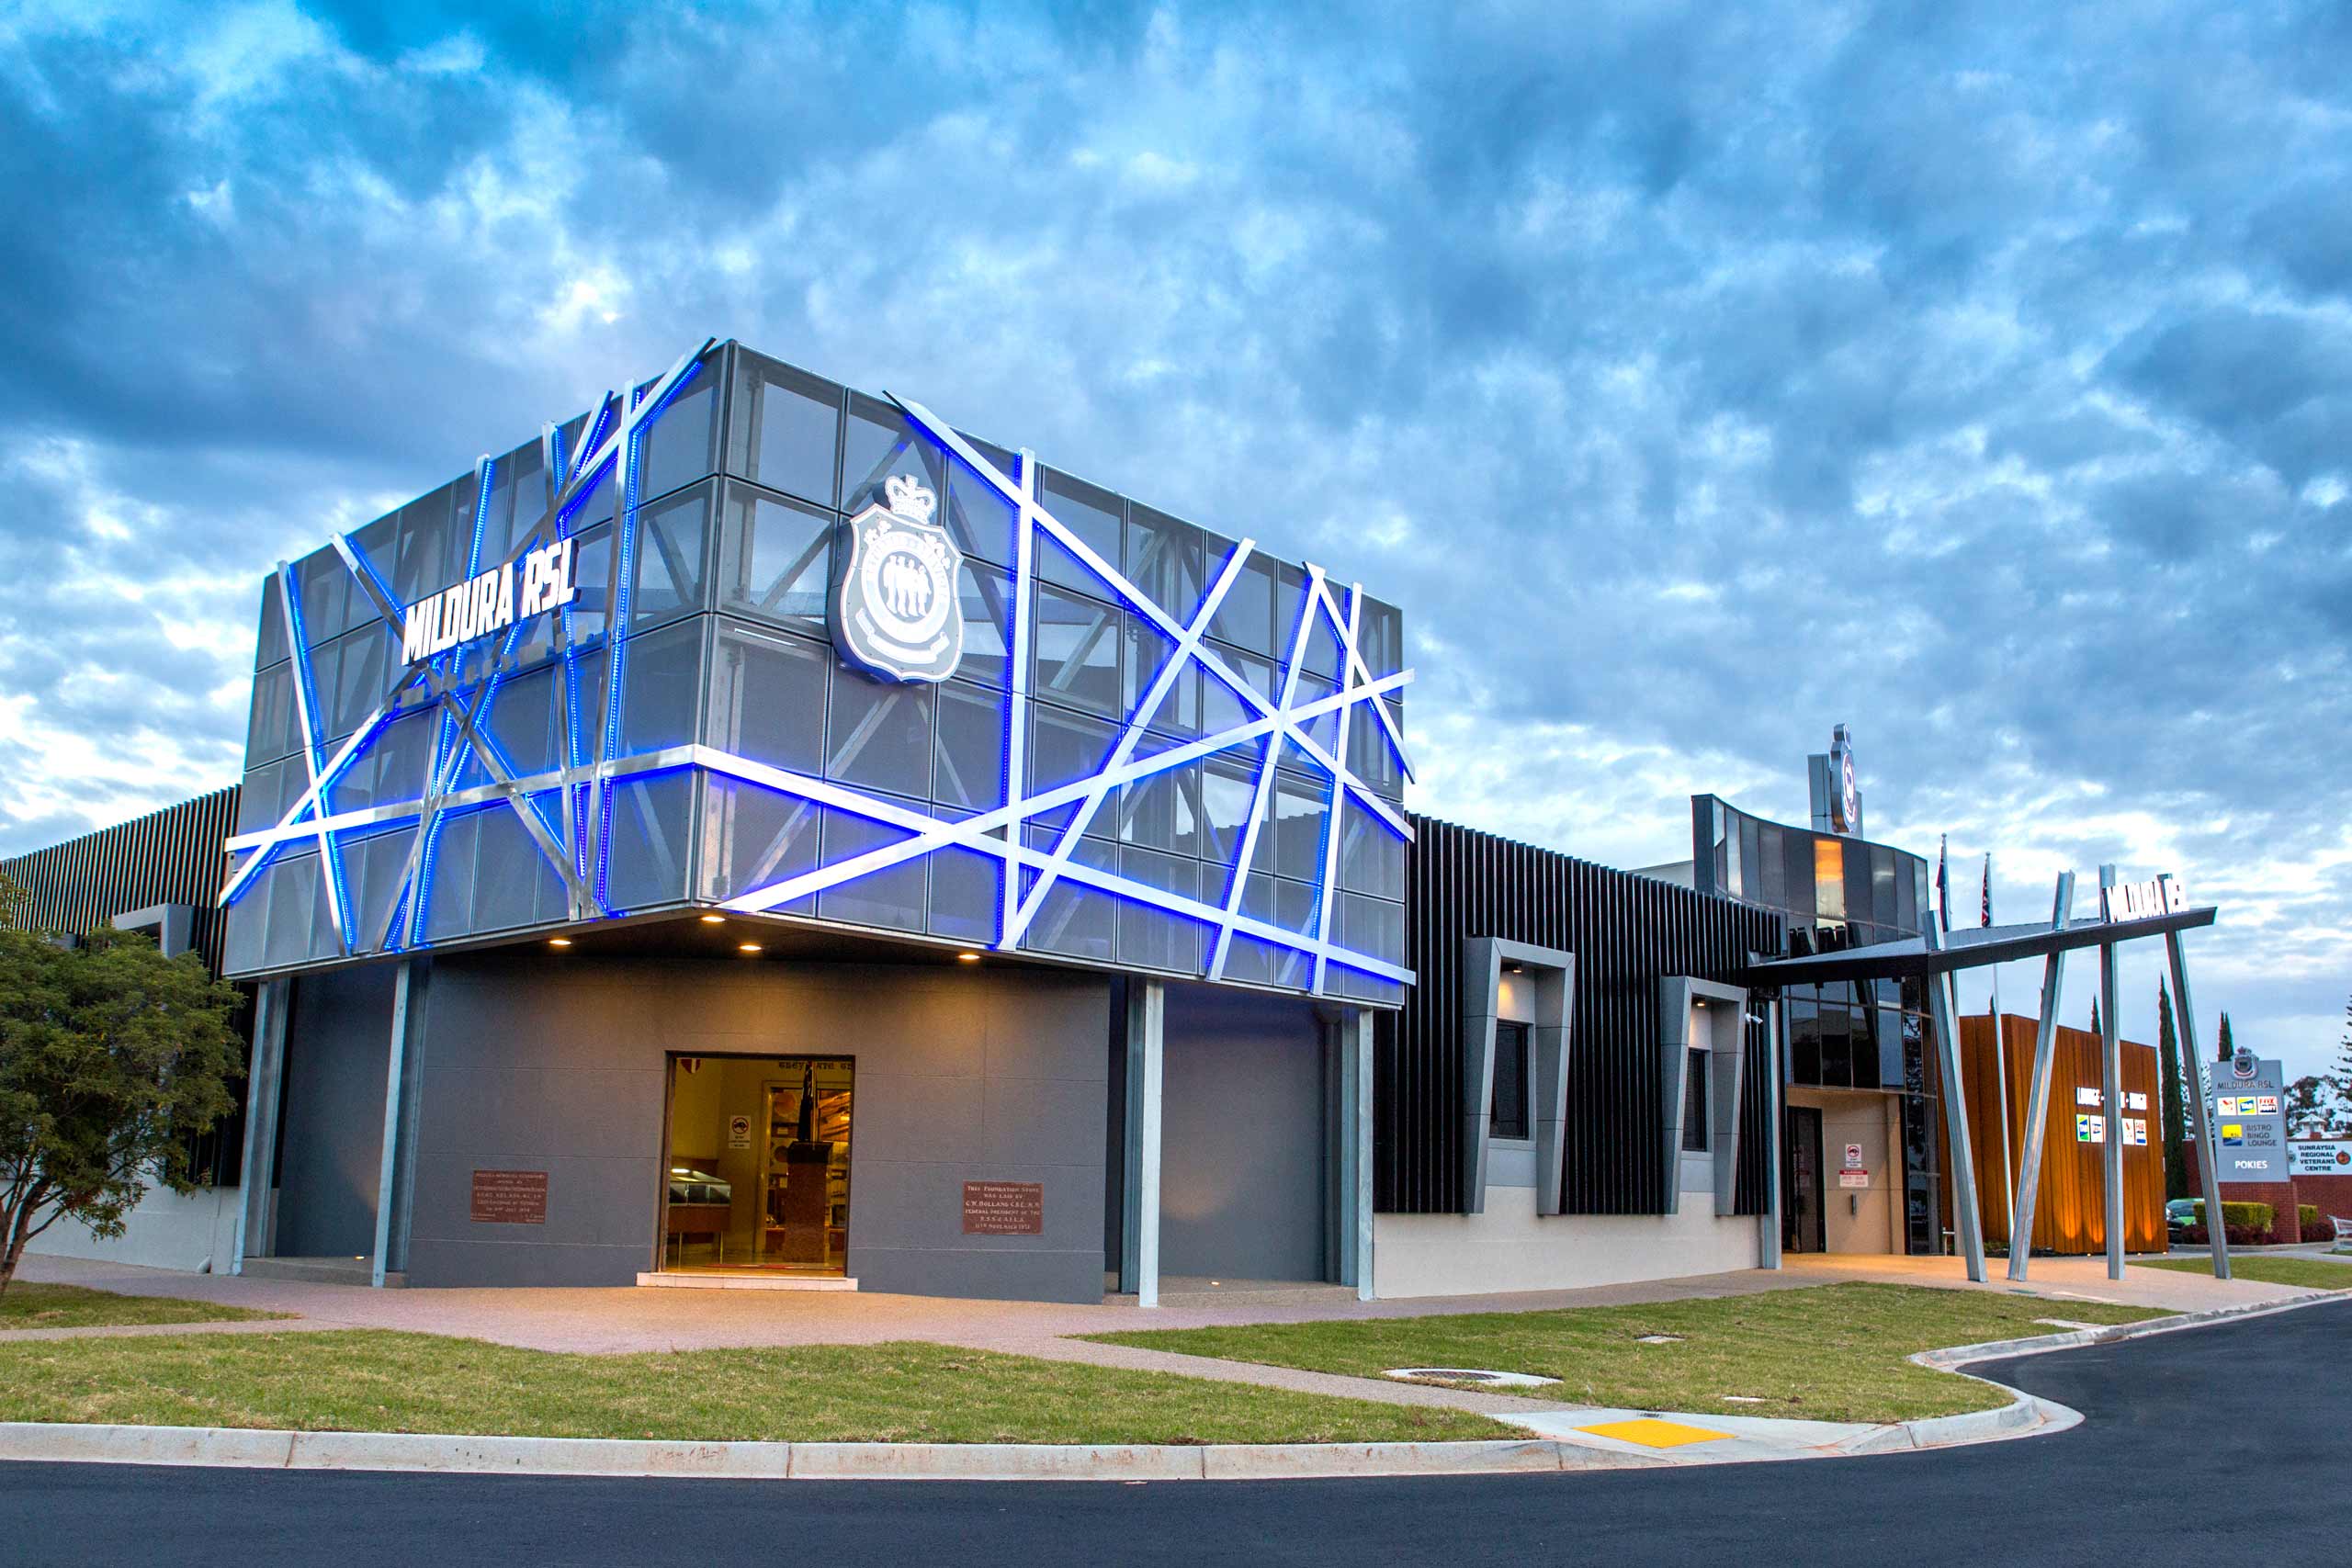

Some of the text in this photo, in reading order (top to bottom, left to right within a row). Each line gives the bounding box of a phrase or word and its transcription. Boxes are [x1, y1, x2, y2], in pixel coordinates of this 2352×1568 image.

[401, 537, 576, 666] MILDURA RSL
[2106, 879, 2165, 923] MILDURA
[2217, 1079, 2274, 1089] MILDURA RSL
[2234, 1160, 2268, 1169] POKIES
